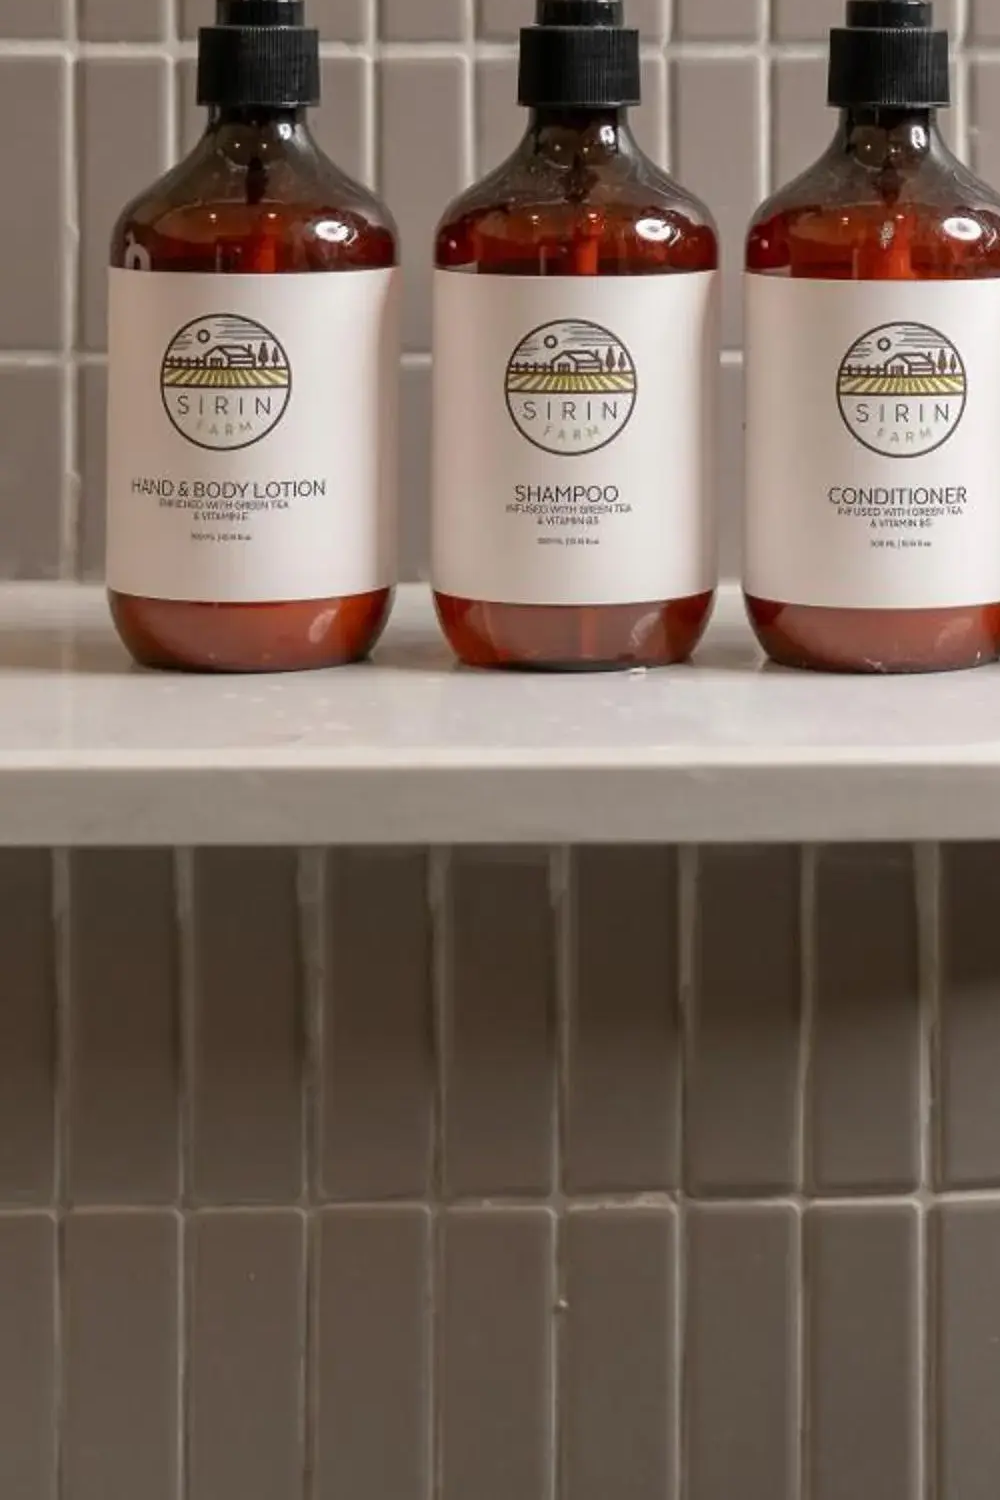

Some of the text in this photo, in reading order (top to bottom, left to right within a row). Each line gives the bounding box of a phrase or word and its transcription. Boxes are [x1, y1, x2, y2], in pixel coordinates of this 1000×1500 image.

[177, 395, 271, 415] SIRIN
[523, 401, 617, 421] SIRIN
[856, 403, 950, 423] SIRIN
[197, 421, 253, 437] FARM
[543, 424, 601, 440] FARM
[876, 426, 932, 444] FARM
[131, 478, 327, 499] HAND & BODY LOTION
[515, 484, 619, 503] SHAMPOO
[828, 486, 967, 506] CONDITIONER
[551, 505, 577, 515] WITH
